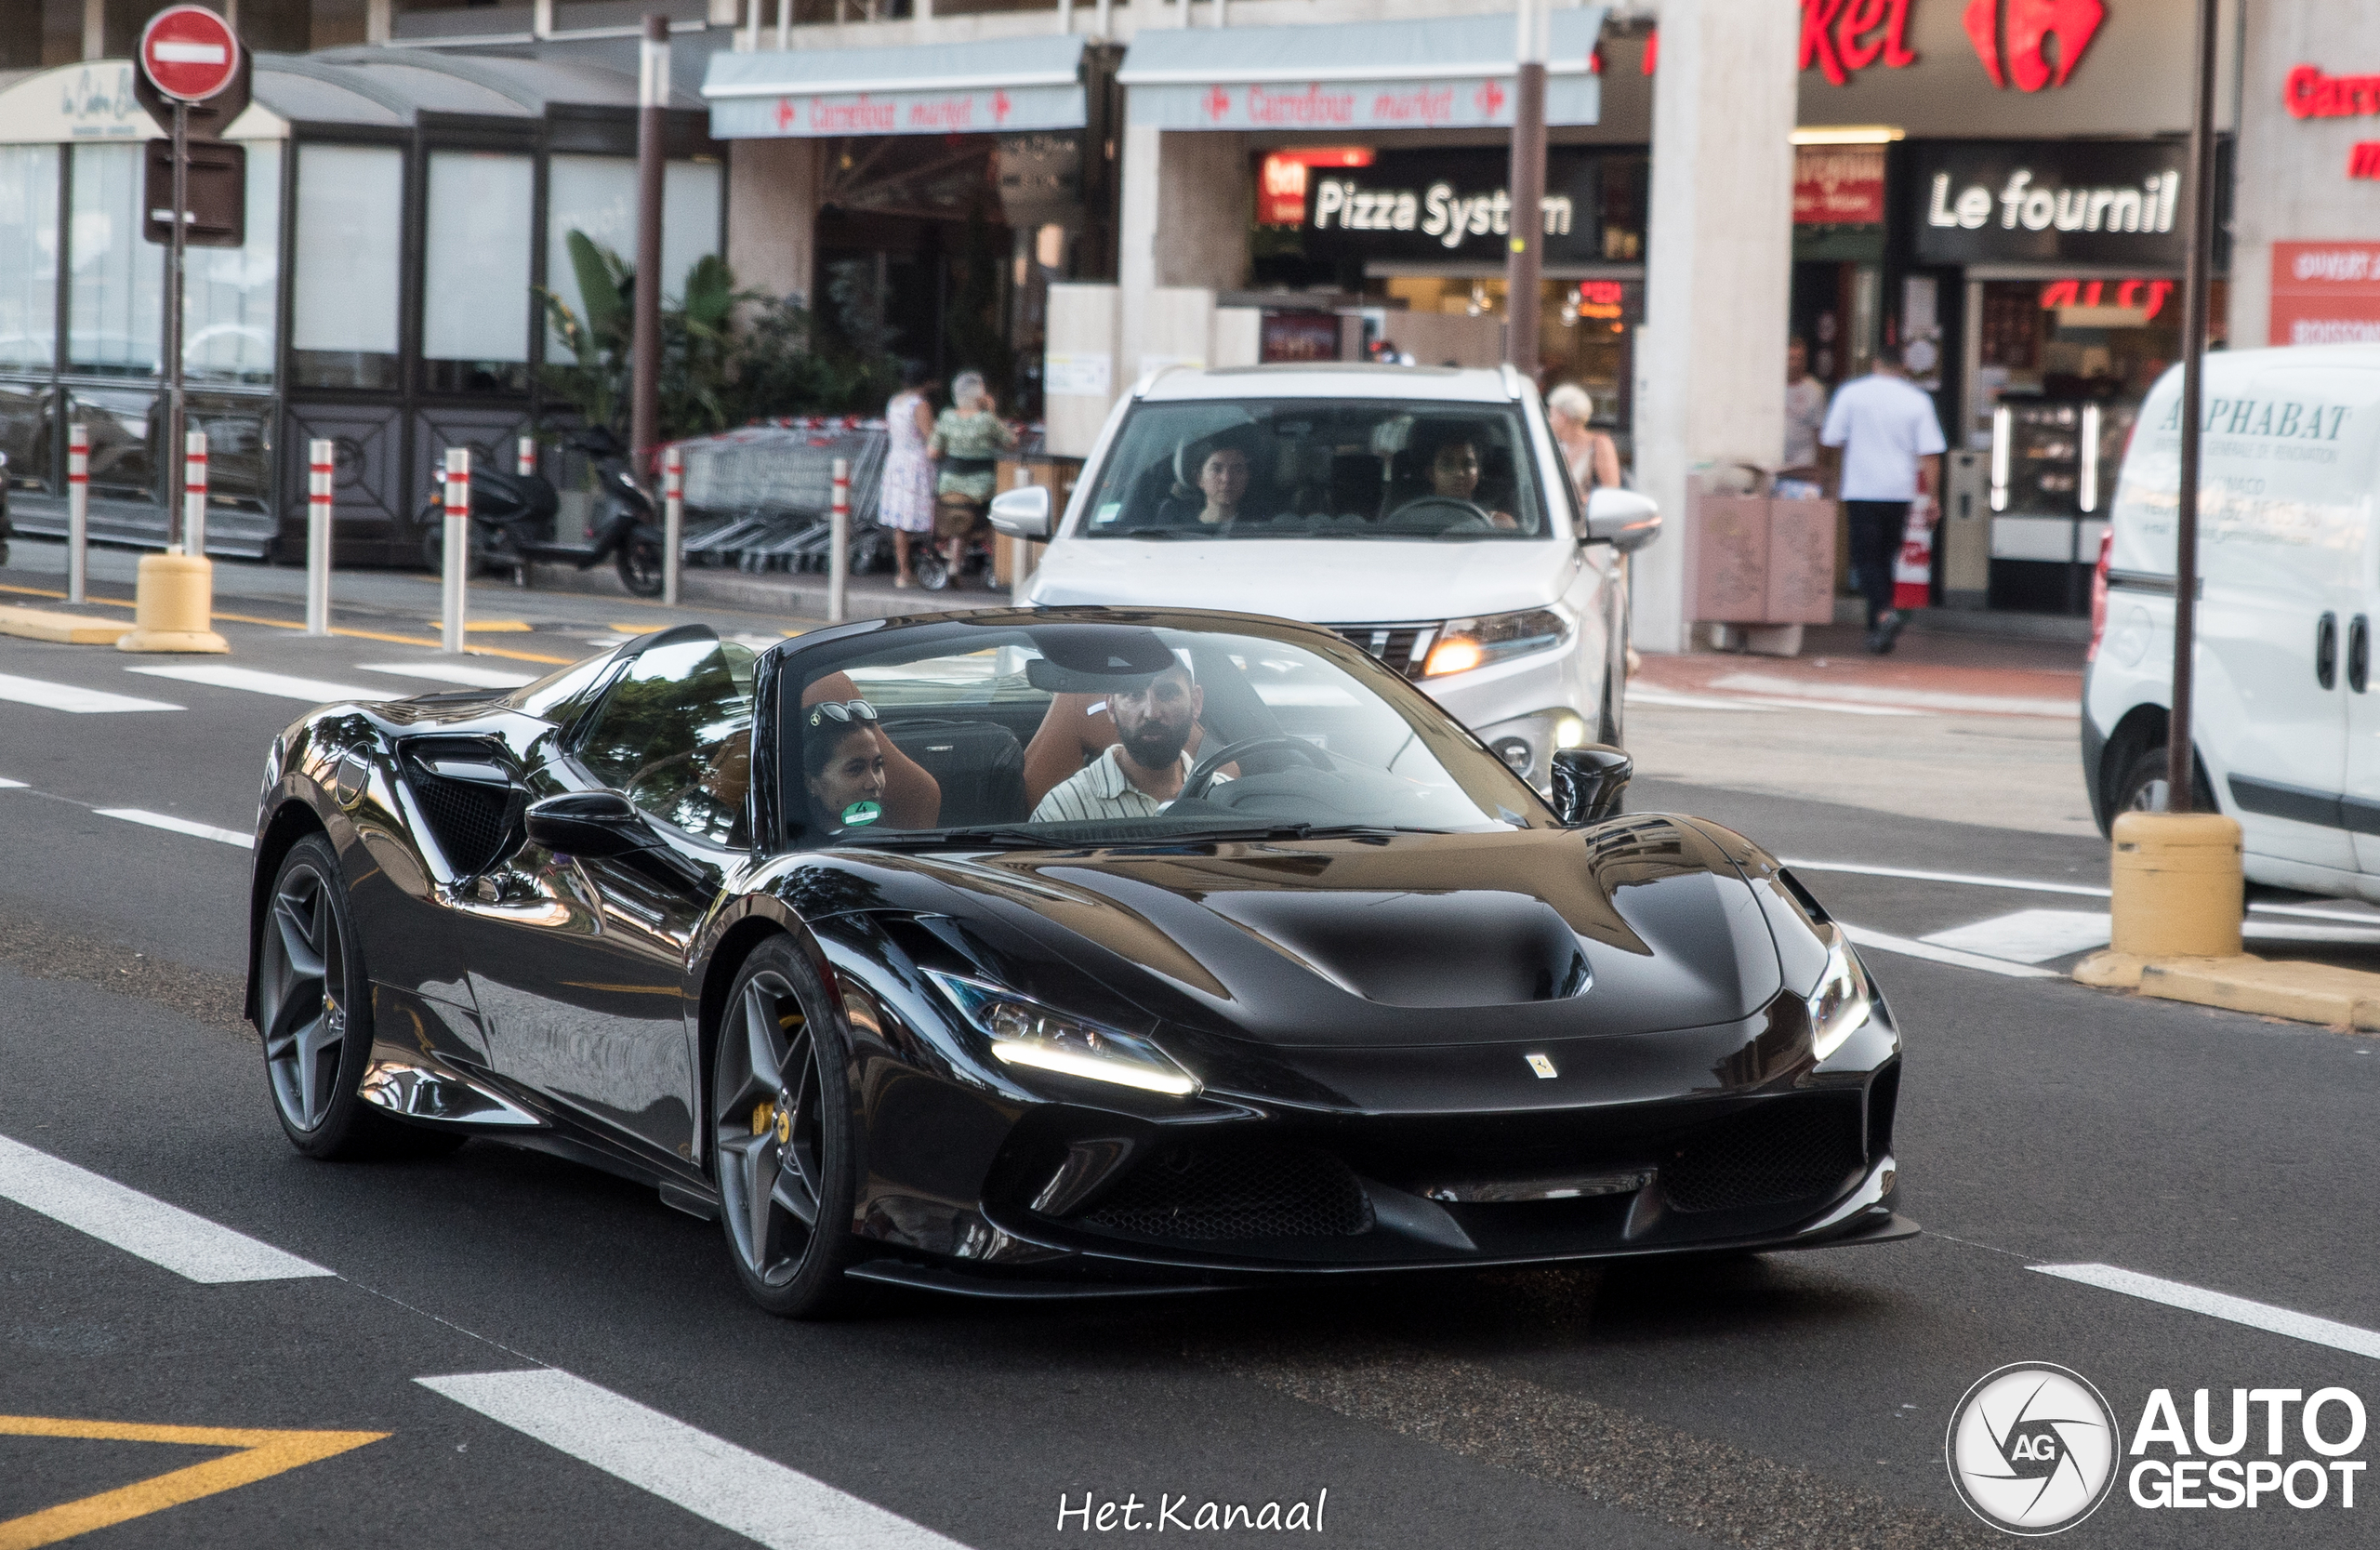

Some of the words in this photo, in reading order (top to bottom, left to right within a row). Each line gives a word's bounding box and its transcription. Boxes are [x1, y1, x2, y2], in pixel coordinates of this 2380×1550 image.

[807, 92, 898, 132] Carrefour
[907, 94, 973, 131] market
[1247, 82, 1355, 123] Carrefour
[1378, 84, 1453, 128] market
[1314, 180, 1420, 231] Pizza
[1421, 183, 1573, 249] Systm
[1928, 174, 1991, 230] Le
[2000, 169, 2180, 232] fournil
[2157, 397, 2351, 441] APHABAT
[855, 801, 867, 814] 4
